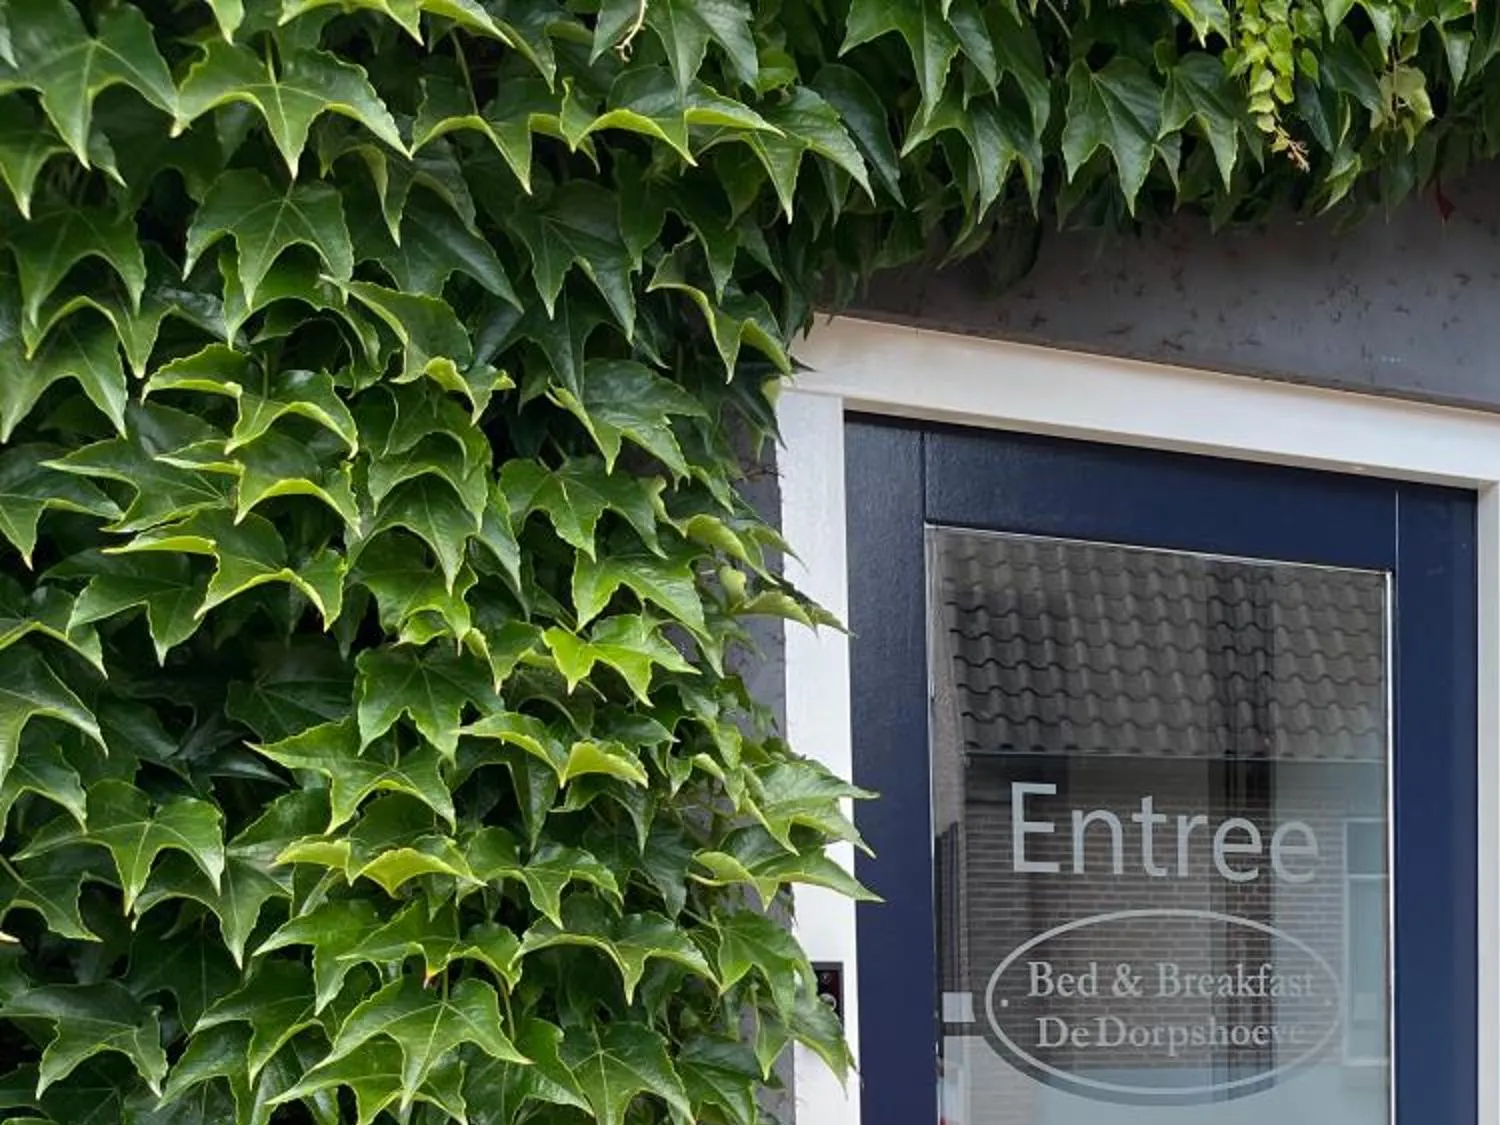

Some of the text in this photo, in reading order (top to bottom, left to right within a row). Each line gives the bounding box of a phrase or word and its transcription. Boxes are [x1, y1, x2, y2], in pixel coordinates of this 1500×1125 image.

[1010, 781, 1319, 883] Entree
[1027, 961, 1316, 998] Bed & Breakfast
